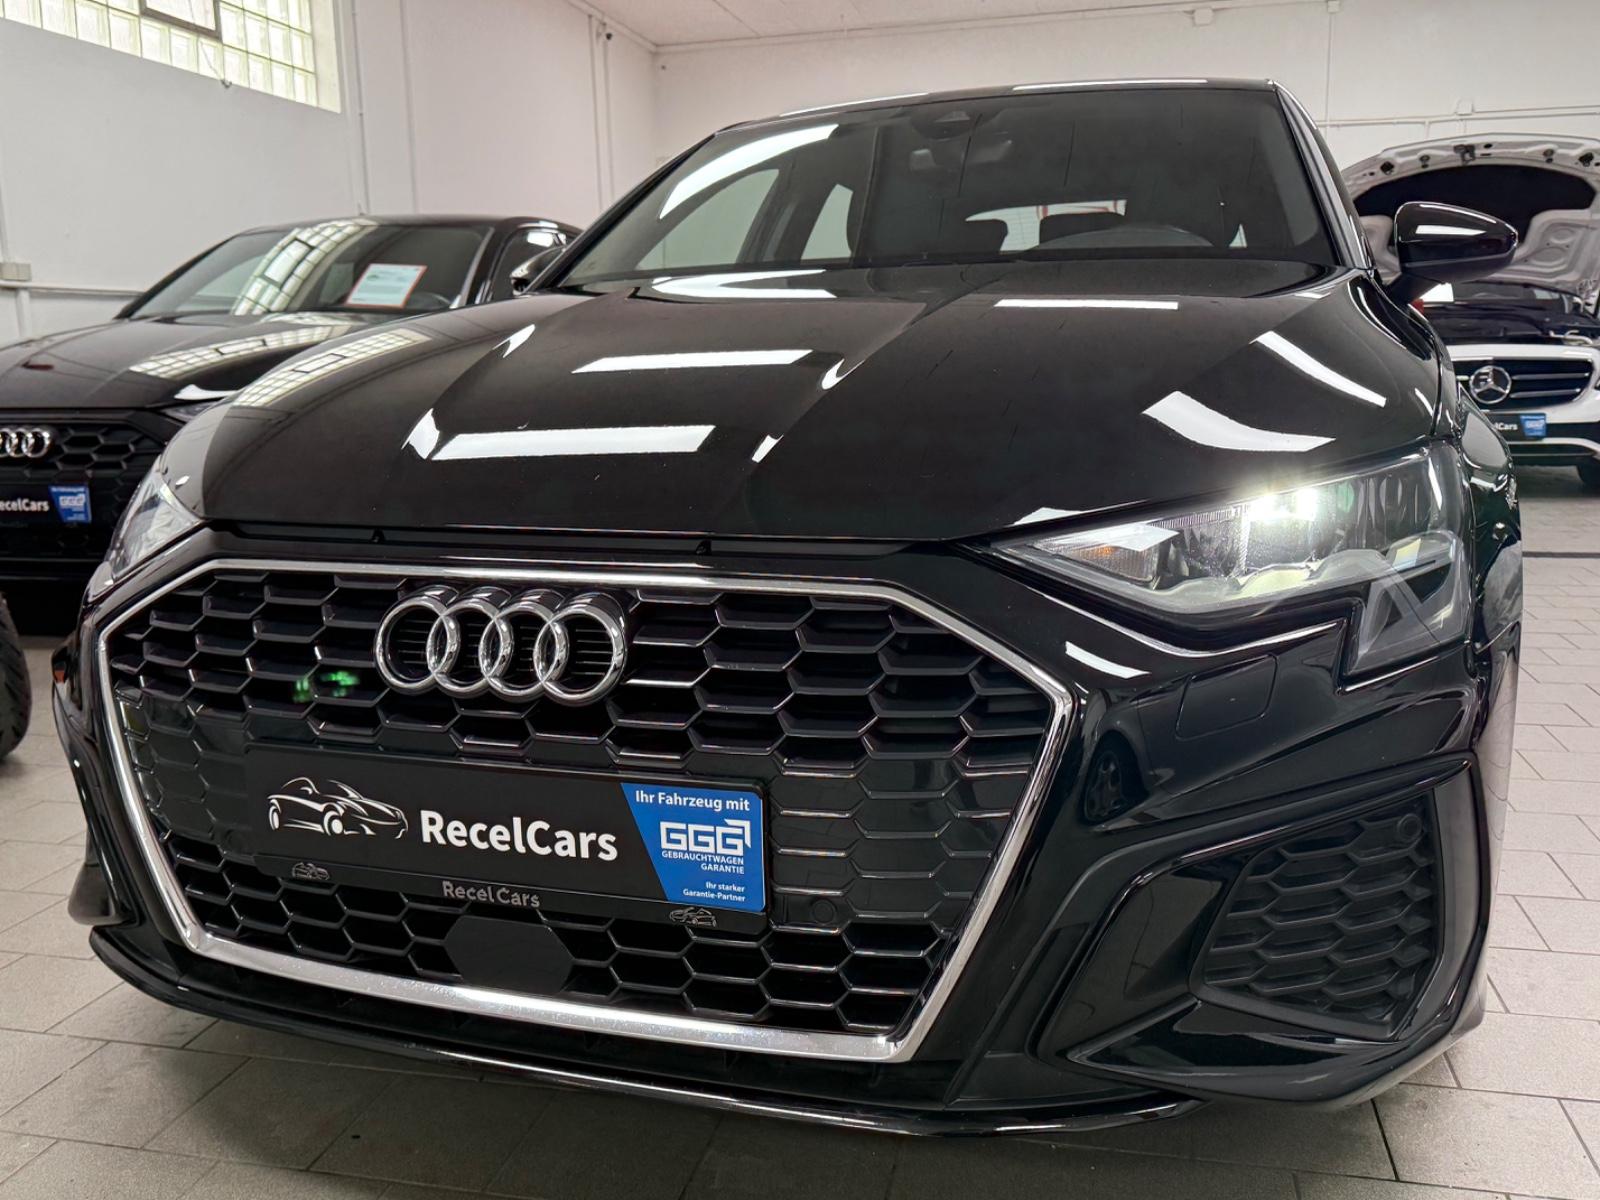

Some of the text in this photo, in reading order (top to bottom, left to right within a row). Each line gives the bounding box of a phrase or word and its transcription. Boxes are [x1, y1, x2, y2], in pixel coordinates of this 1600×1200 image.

[635, 790, 750, 812] Ihr Fahrzeug mit
[420, 809, 618, 861] RecelCars
[659, 820, 746, 856] GGG
[661, 850, 744, 865] GEBRAUCHTWAGEN
[701, 862, 745, 874] GARANTIE
[705, 881, 745, 893] Ihr starker
[682, 888, 746, 902] Garantie-Partner
